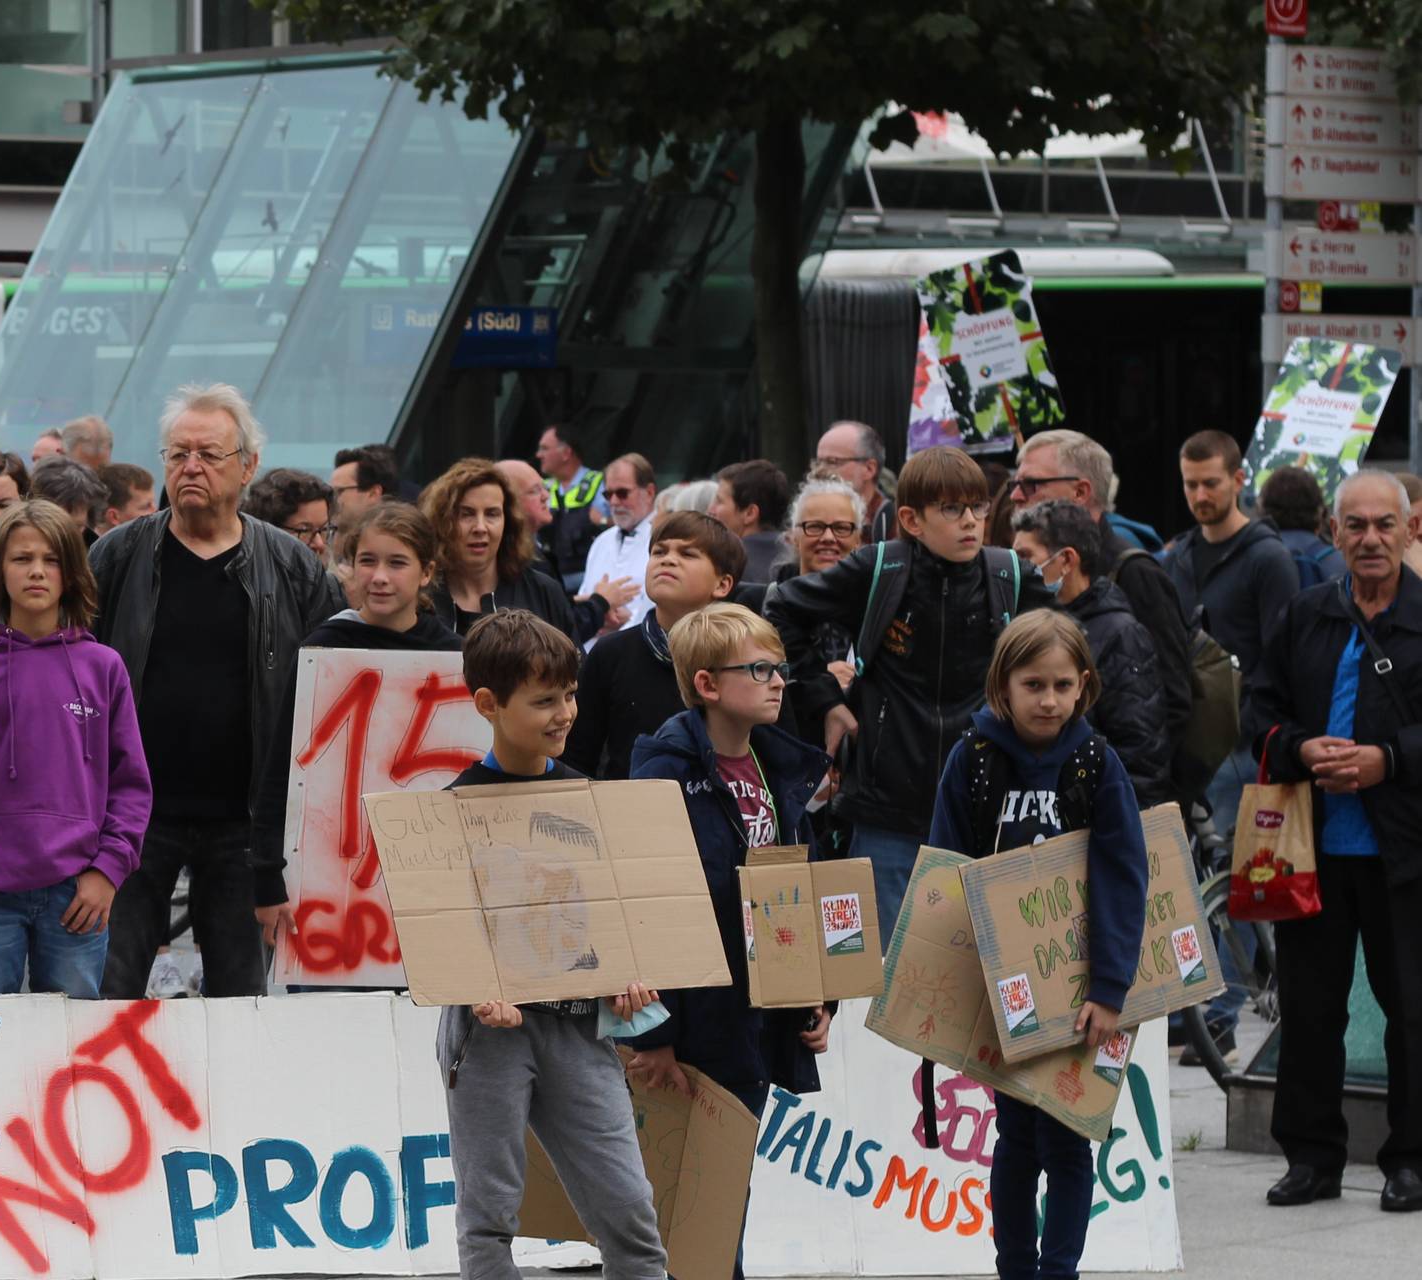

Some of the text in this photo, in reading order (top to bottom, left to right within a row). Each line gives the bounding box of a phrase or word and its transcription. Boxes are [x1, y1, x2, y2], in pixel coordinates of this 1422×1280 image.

[1324, 242, 1356, 255] Herne
[477, 312, 521, 332] (Süd)
[956, 315, 1014, 341] SCHÖPFUNG
[1296, 395, 1356, 412] SCHÖPFUNG
[822, 897, 858, 912] KLIMA
[1018, 876, 1073, 928] WIR
[289, 900, 401, 972] GR
[1033, 928, 1079, 980] DAS
